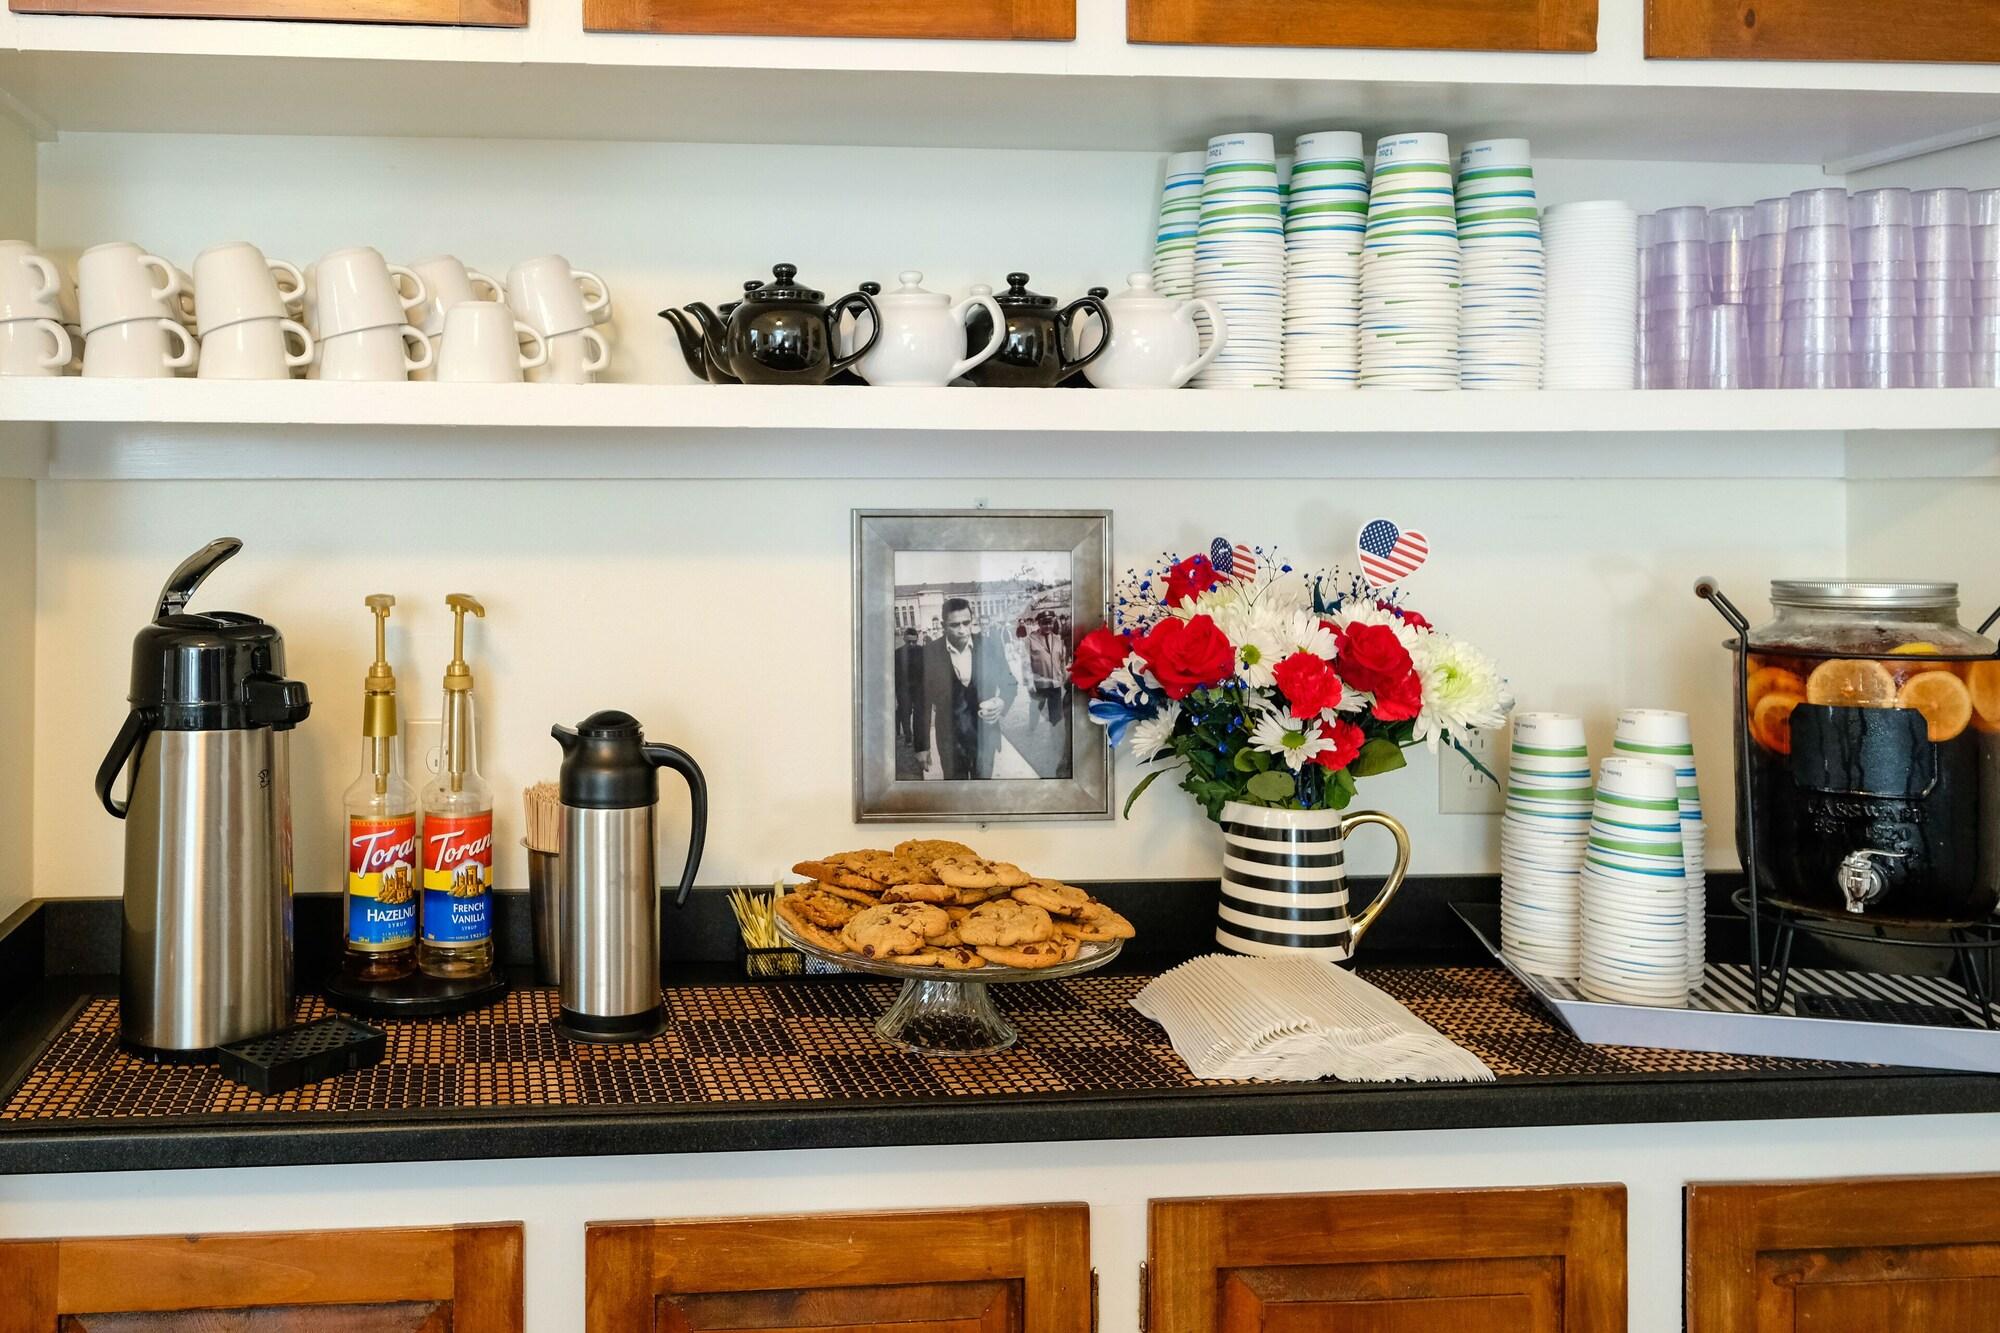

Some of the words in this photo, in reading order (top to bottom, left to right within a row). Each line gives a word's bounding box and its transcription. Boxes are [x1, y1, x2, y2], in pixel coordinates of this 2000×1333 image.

[453, 902, 485, 913] FRENCH
[451, 913, 486, 924] VANILLA
[388, 921, 407, 929] SYRUP
